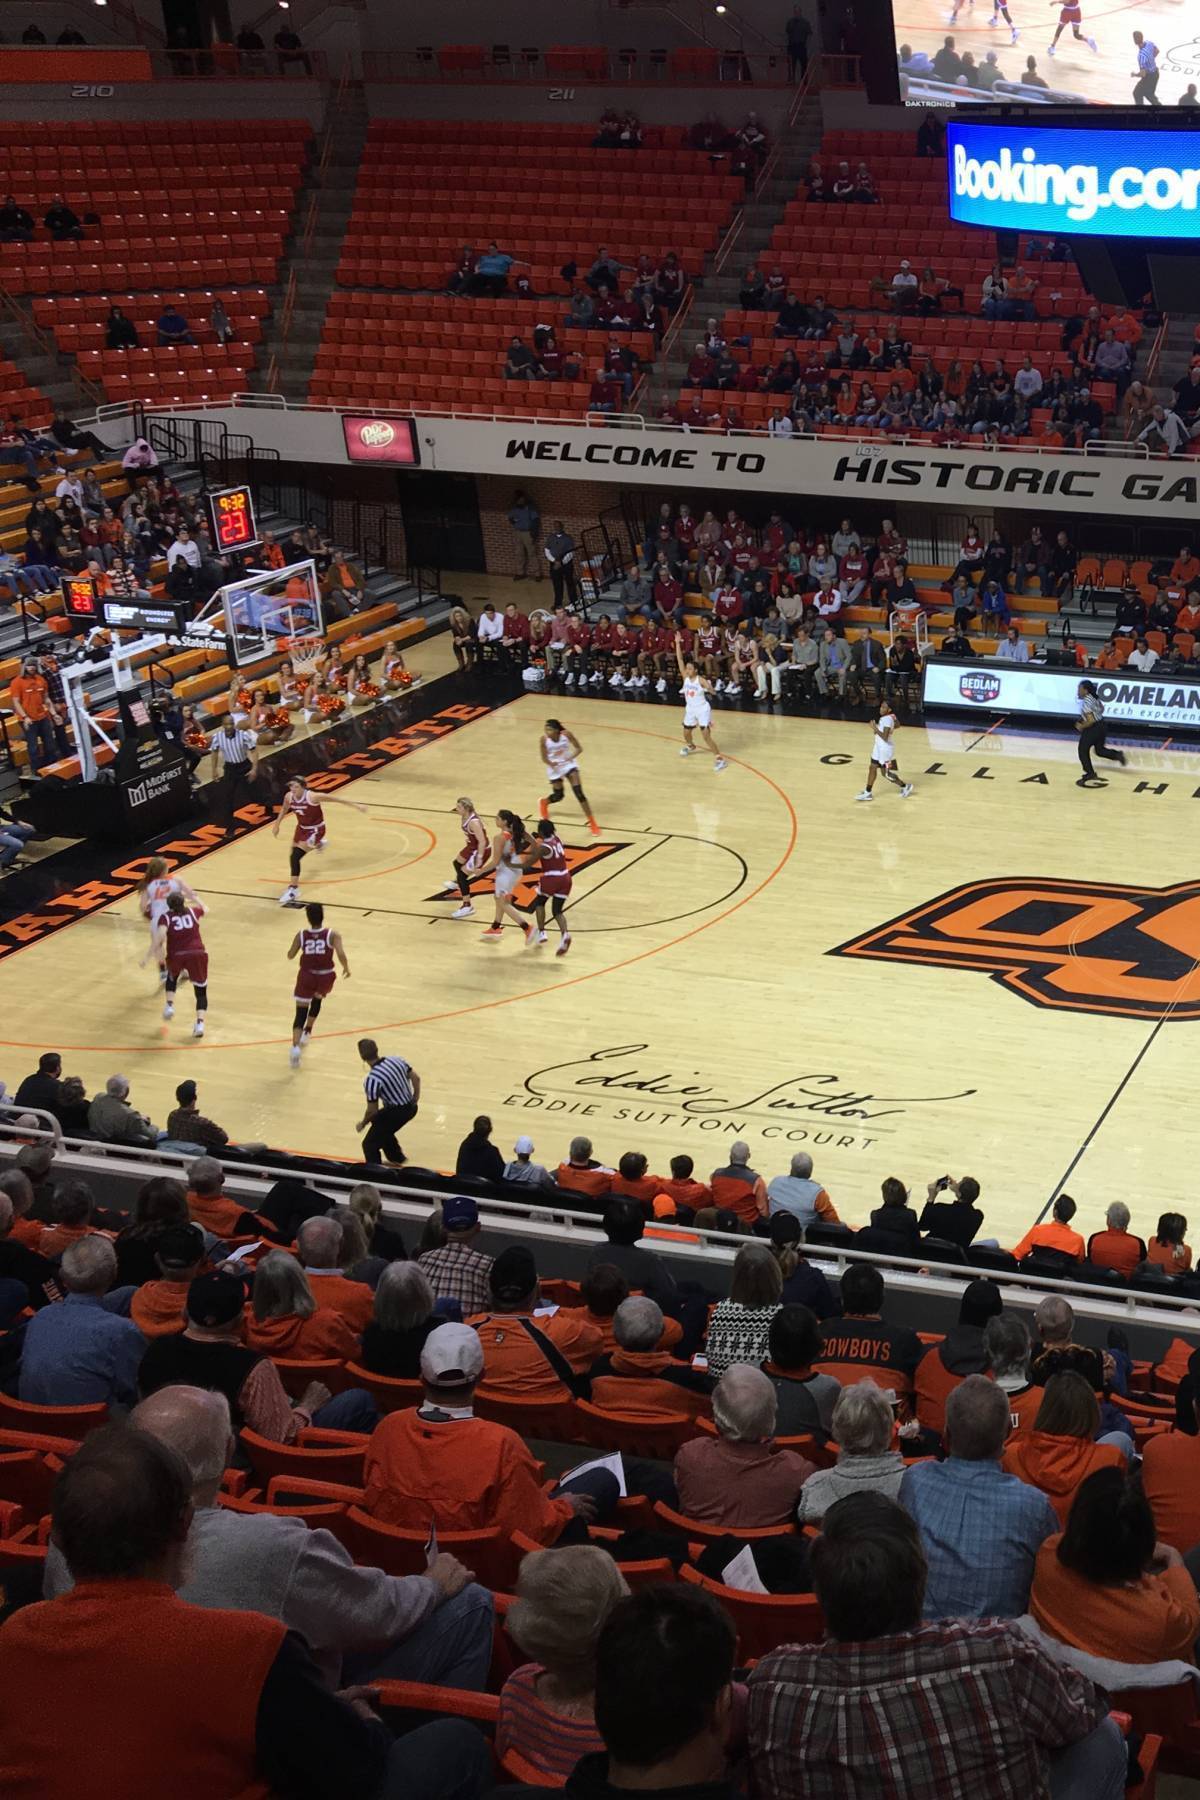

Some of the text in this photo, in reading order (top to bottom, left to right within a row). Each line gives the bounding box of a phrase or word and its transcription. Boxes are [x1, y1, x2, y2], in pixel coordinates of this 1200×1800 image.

[71, 85, 114, 97] 210
[548, 88, 575, 100] 211
[905, 100, 956, 108] DAKTRONICS
[505, 439, 766, 473] WELCOME TO
[856, 446, 886, 456] 107
[833, 456, 1101, 497] HISTORIC
[219, 493, 245, 511] 9:32
[220, 511, 246, 542] 23
[72, 594, 93, 611] 23
[961, 677, 999, 691] BEDLAM
[303, 704, 491, 791] STATE
[171, 914, 193, 931] 30
[304, 939, 326, 954] 22
[503, 1094, 880, 1151] EDDIE SUTTON COURT
